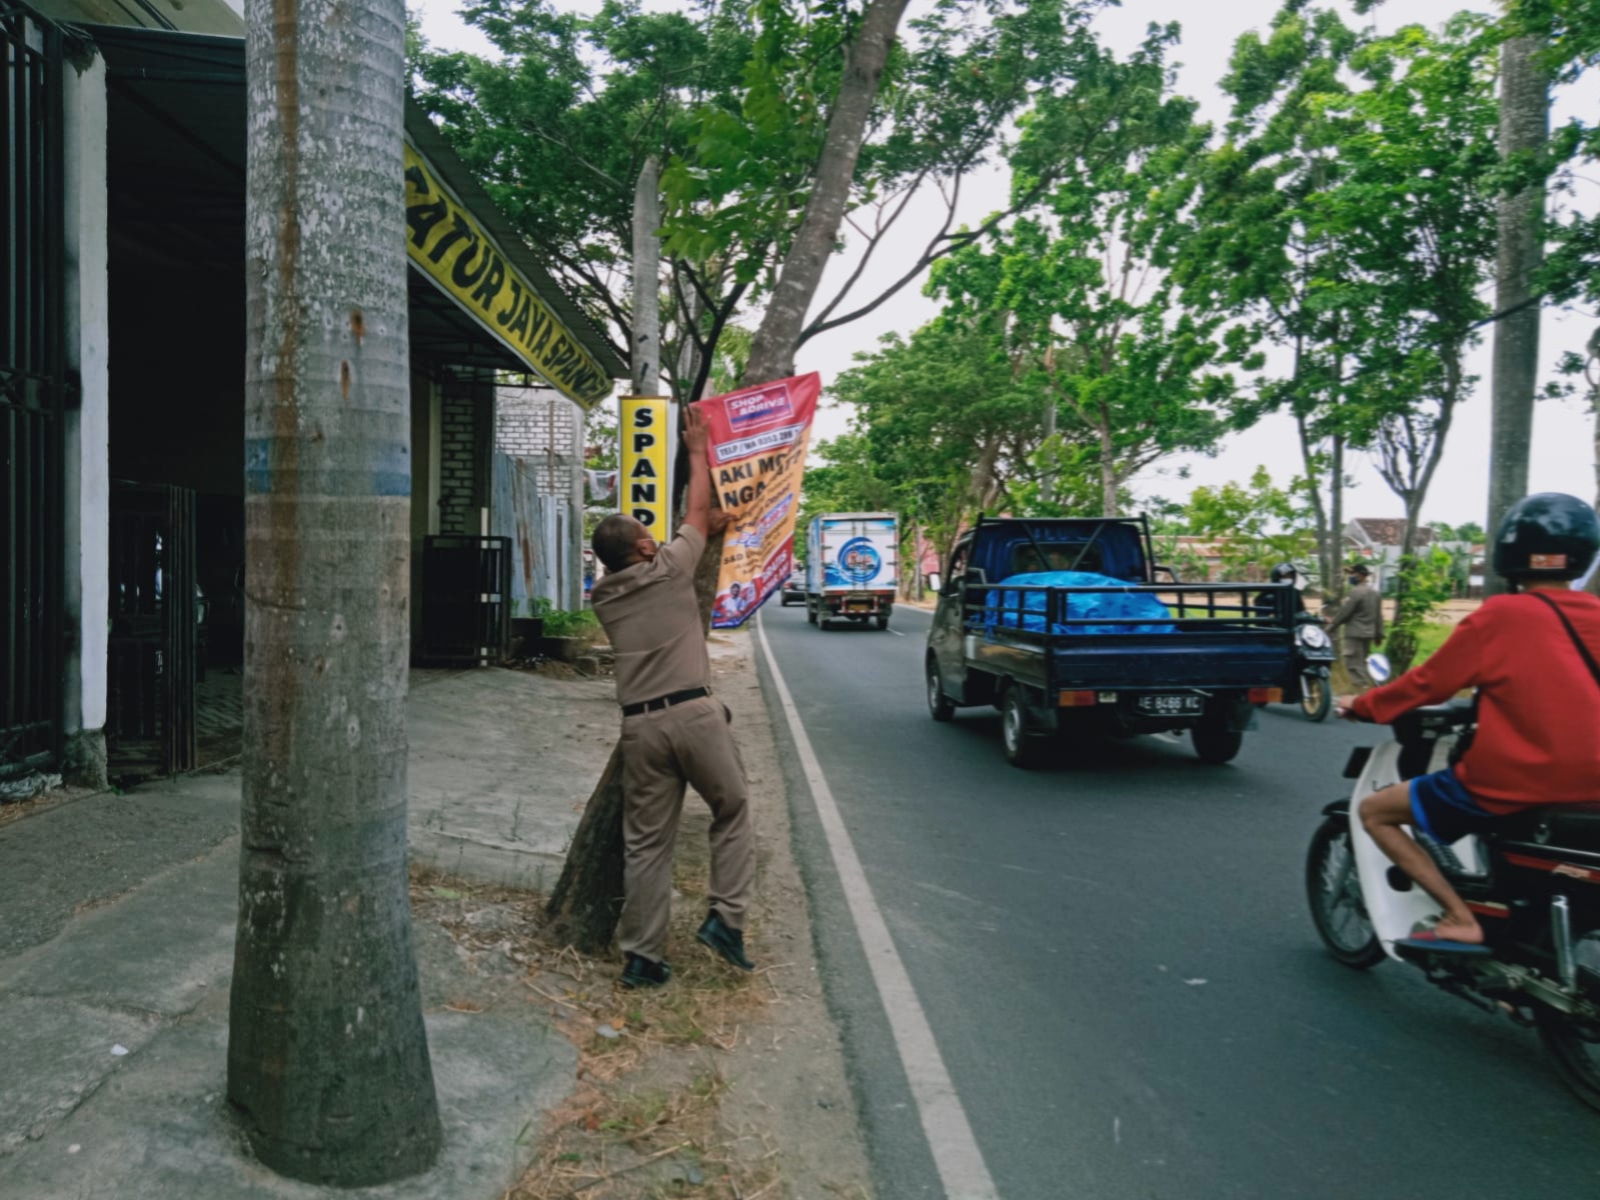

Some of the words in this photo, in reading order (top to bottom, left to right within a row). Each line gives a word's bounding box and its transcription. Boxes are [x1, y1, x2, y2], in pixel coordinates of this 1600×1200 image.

[497, 278, 553, 360] JAYA
[731, 394, 765, 409] SHOP
[720, 462, 753, 486] AKI
